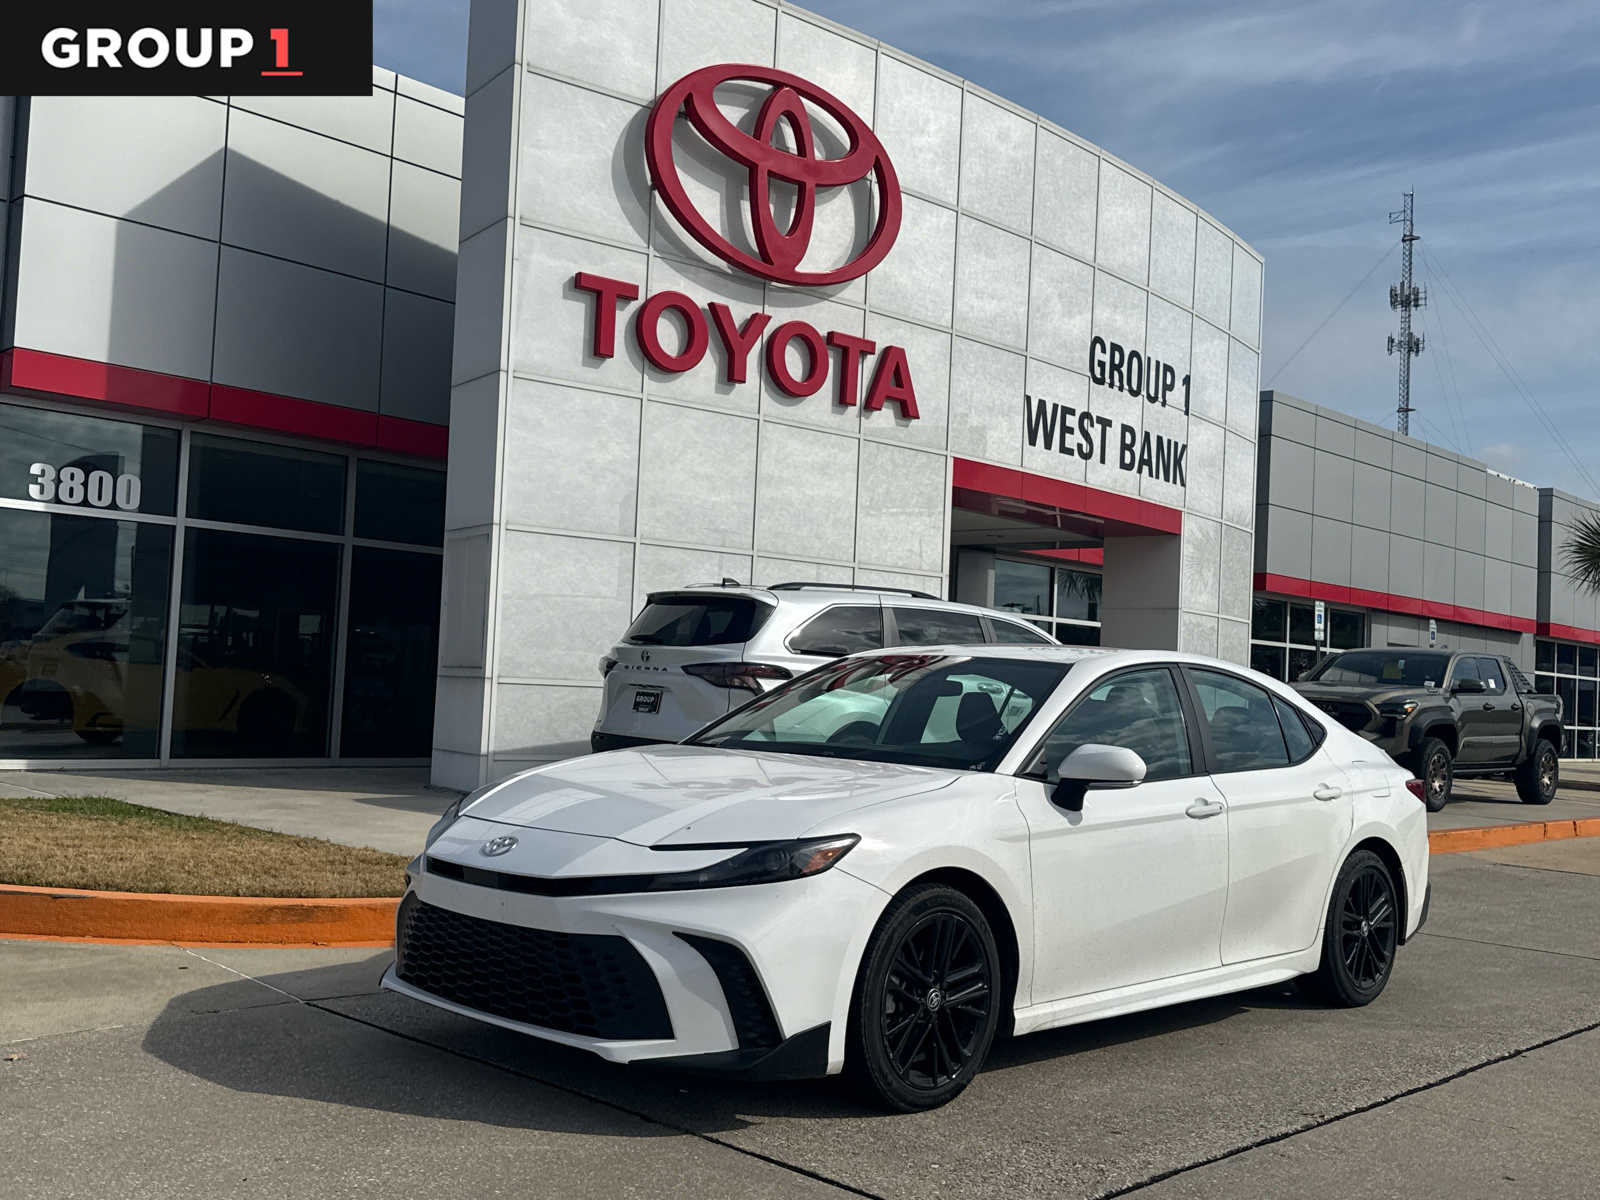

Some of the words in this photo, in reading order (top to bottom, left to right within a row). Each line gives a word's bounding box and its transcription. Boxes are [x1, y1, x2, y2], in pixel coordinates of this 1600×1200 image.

[575, 271, 920, 420] TOYOTA
[1089, 336, 1175, 407] GROUP
[1182, 374, 1191, 416] 1
[1025, 394, 1112, 464] WEST
[1119, 423, 1187, 488] BANK
[28, 462, 141, 510] 3800
